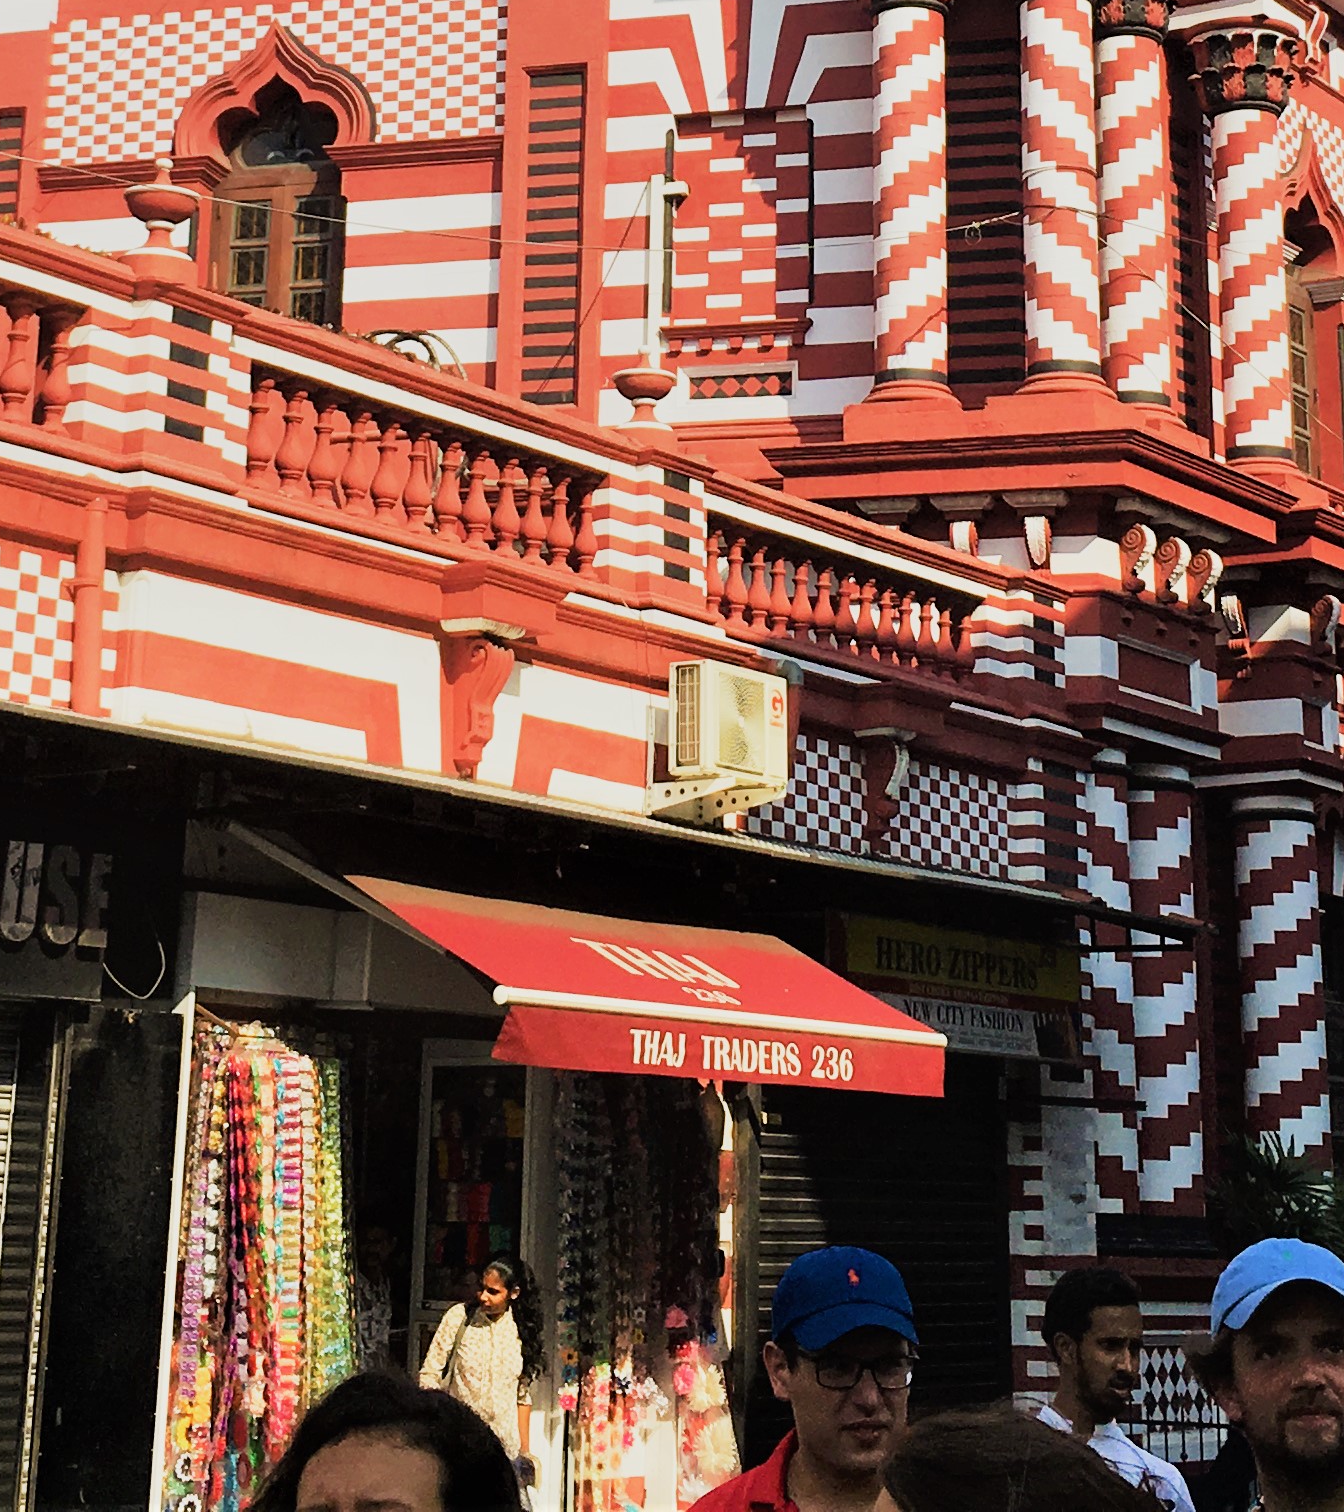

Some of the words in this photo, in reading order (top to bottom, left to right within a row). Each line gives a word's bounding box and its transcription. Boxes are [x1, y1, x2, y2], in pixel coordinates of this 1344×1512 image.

[569, 937, 741, 989] THAJ
[876, 935, 941, 977] HERO
[947, 946, 1040, 991] ZIPPERS
[903, 998, 931, 1023] NEW
[937, 1002, 965, 1028] CITY
[970, 1007, 1024, 1033] FASHION
[630, 1029, 687, 1068] THAJ
[701, 1035, 802, 1076] TRADERS
[811, 1045, 854, 1082] 236
